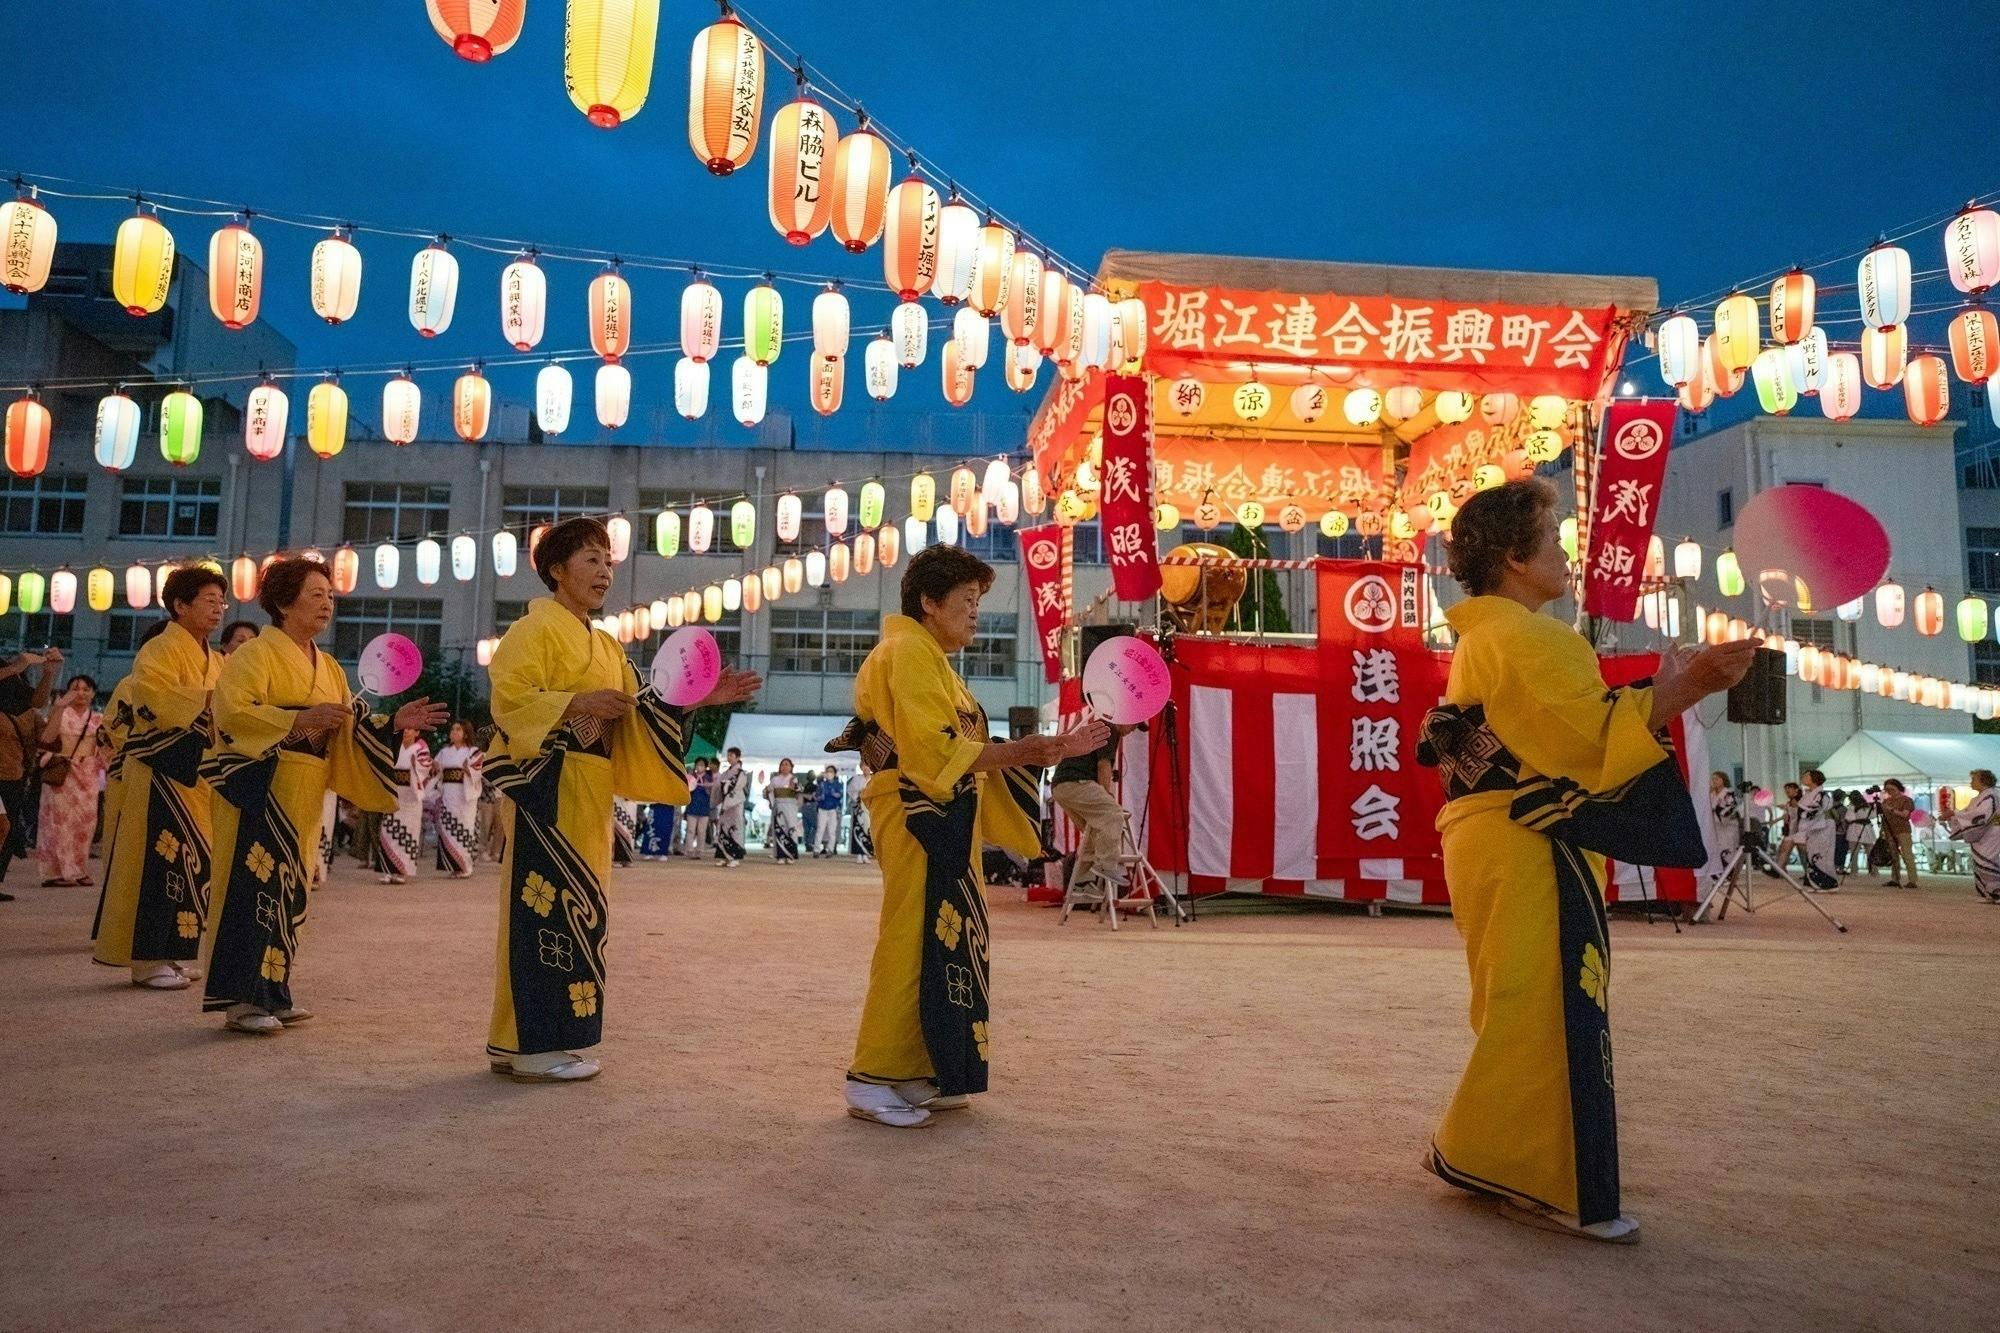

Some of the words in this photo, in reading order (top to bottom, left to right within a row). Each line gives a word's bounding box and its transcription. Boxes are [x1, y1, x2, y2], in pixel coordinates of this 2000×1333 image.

[794, 110, 825, 203] 森脇ビル
[1153, 291, 1602, 370] 堀江連合振興町会
[1176, 384, 1201, 407] 納
[1239, 388, 1265, 411] 涼
[1102, 455, 1149, 568] 浅照
[1242, 506, 1260, 520] お
[1286, 509, 1303, 525] 盆
[1402, 570, 1417, 625] 河内音頭
[1348, 647, 1402, 843] 浅照会
